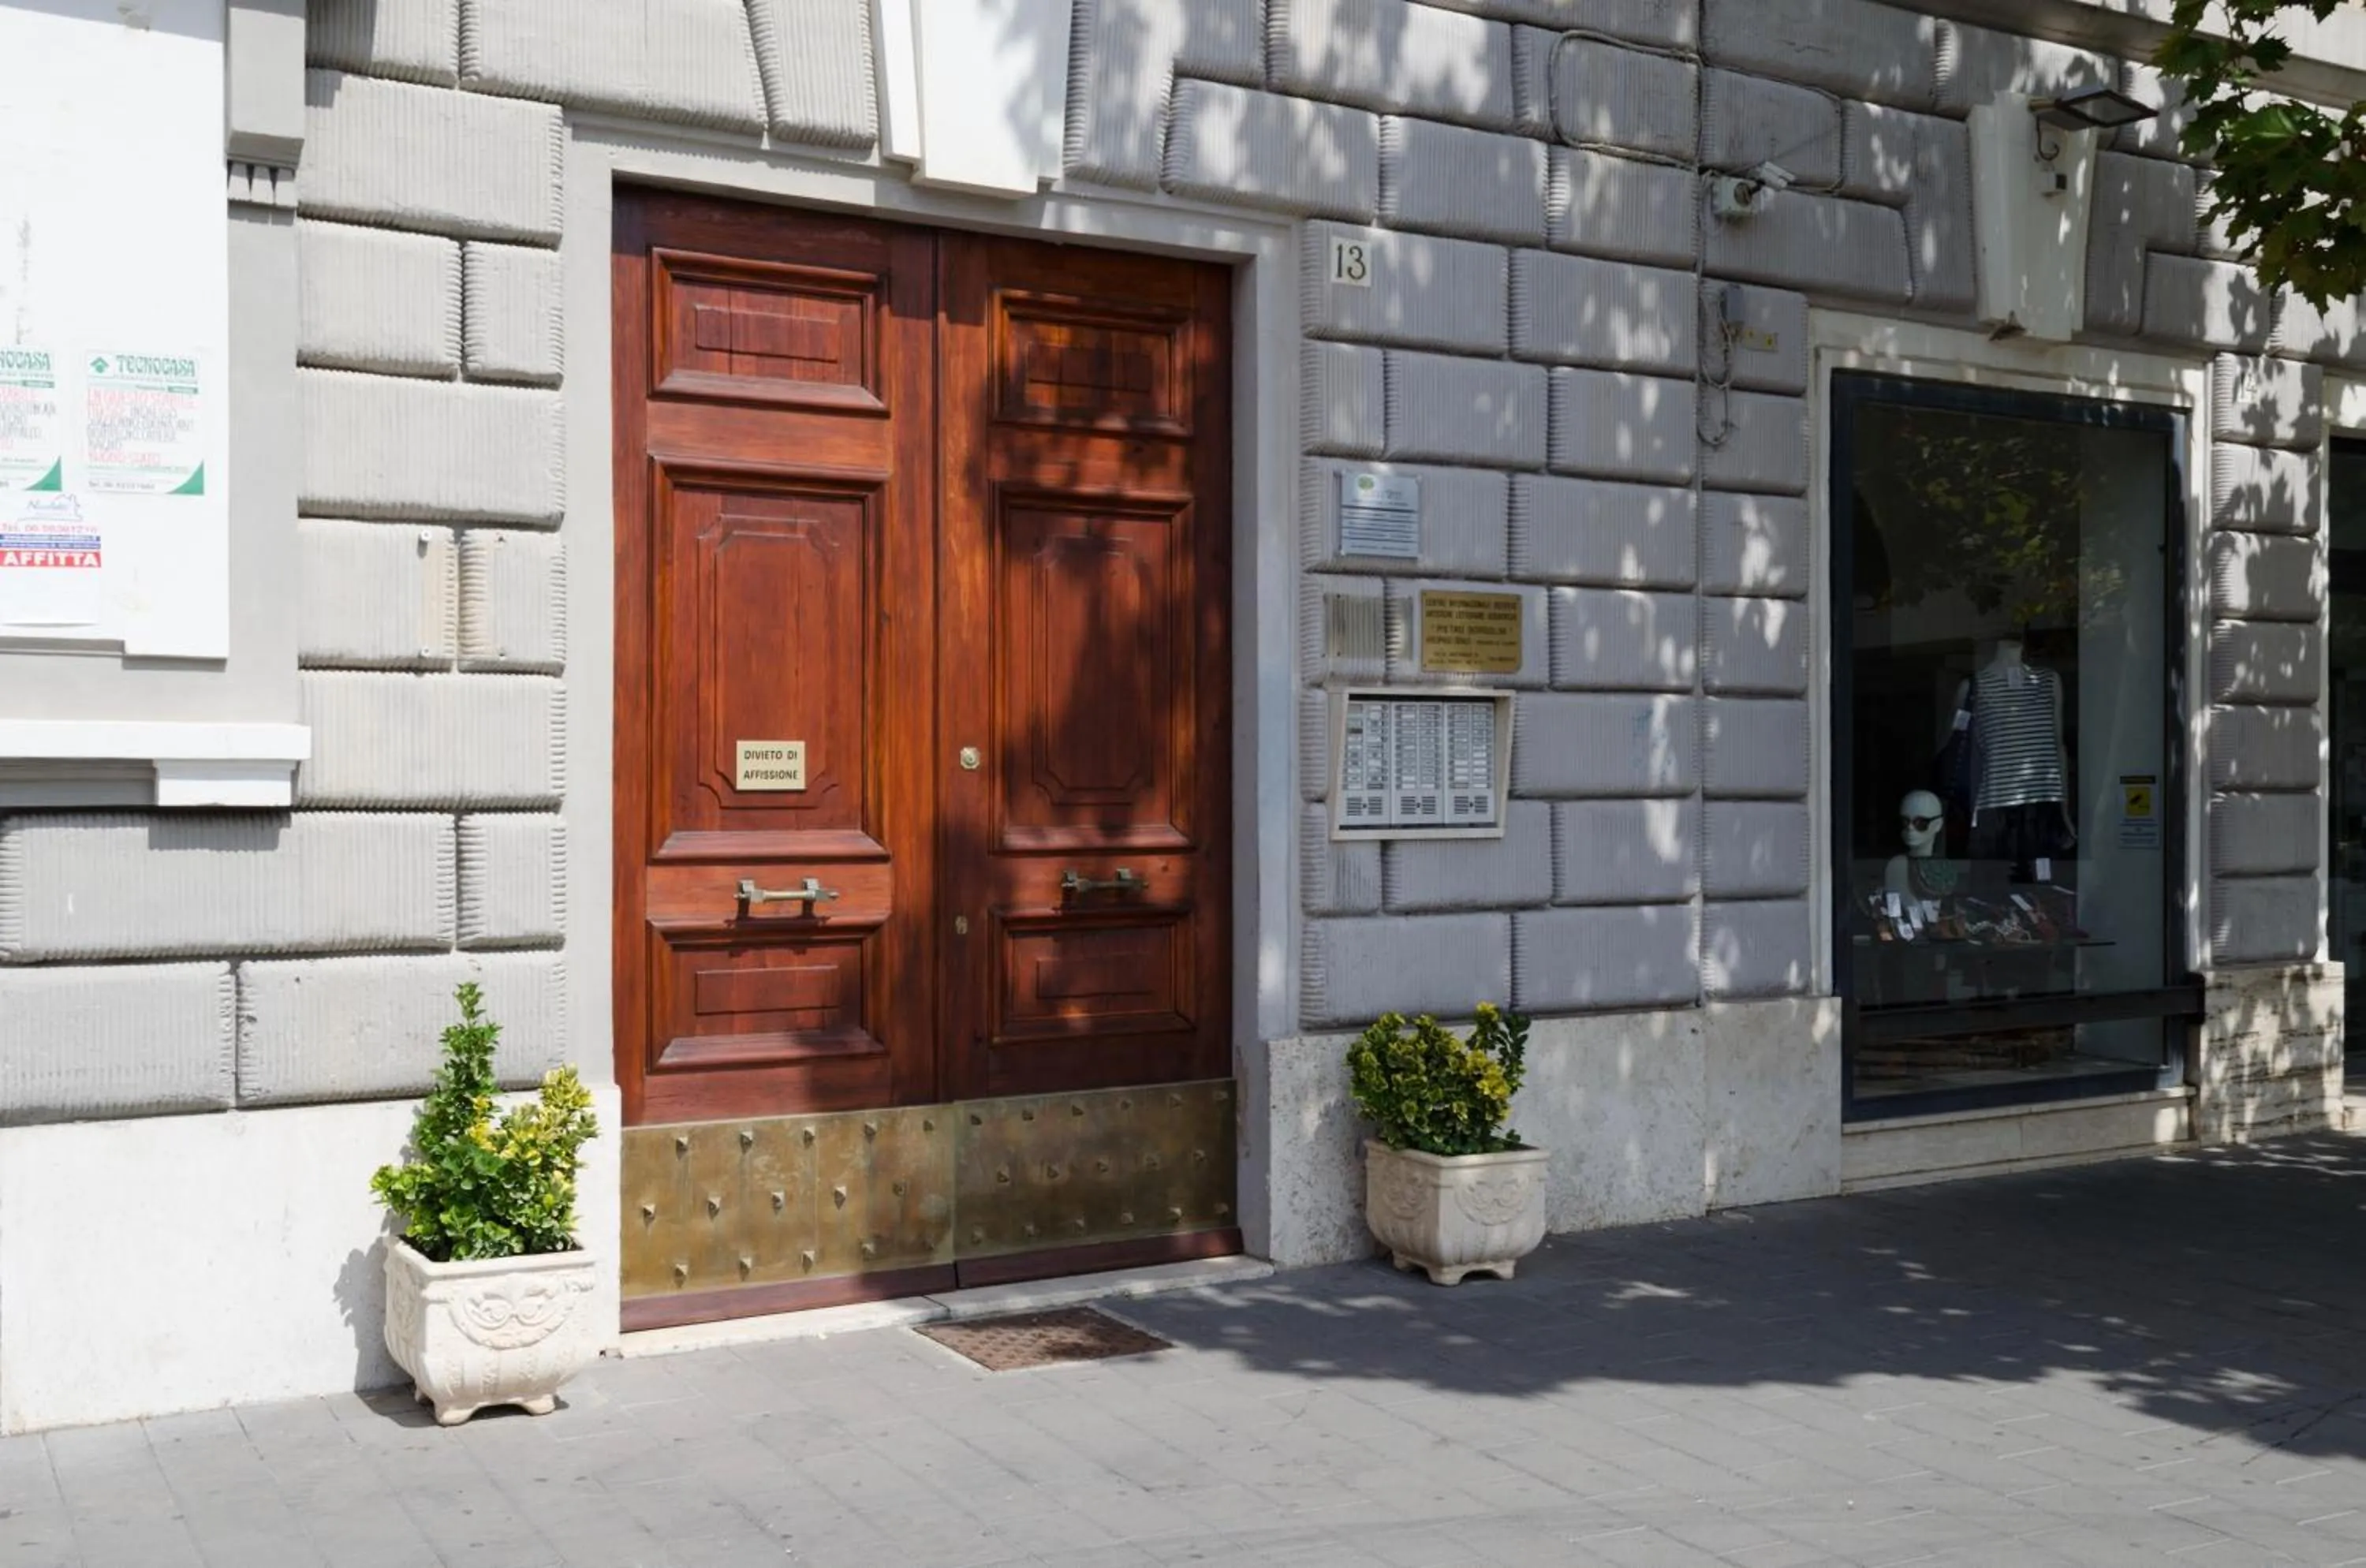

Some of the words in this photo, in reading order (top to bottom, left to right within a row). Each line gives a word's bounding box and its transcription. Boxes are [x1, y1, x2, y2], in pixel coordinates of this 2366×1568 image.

[1337, 244, 1366, 280] 13
[116, 354, 196, 377] TECNOCASA
[3, 551, 99, 567] AFFITTA
[744, 750, 783, 760] DIVIETO
[787, 750, 797, 760] DI
[744, 770, 797, 779] AFFISSIONE
